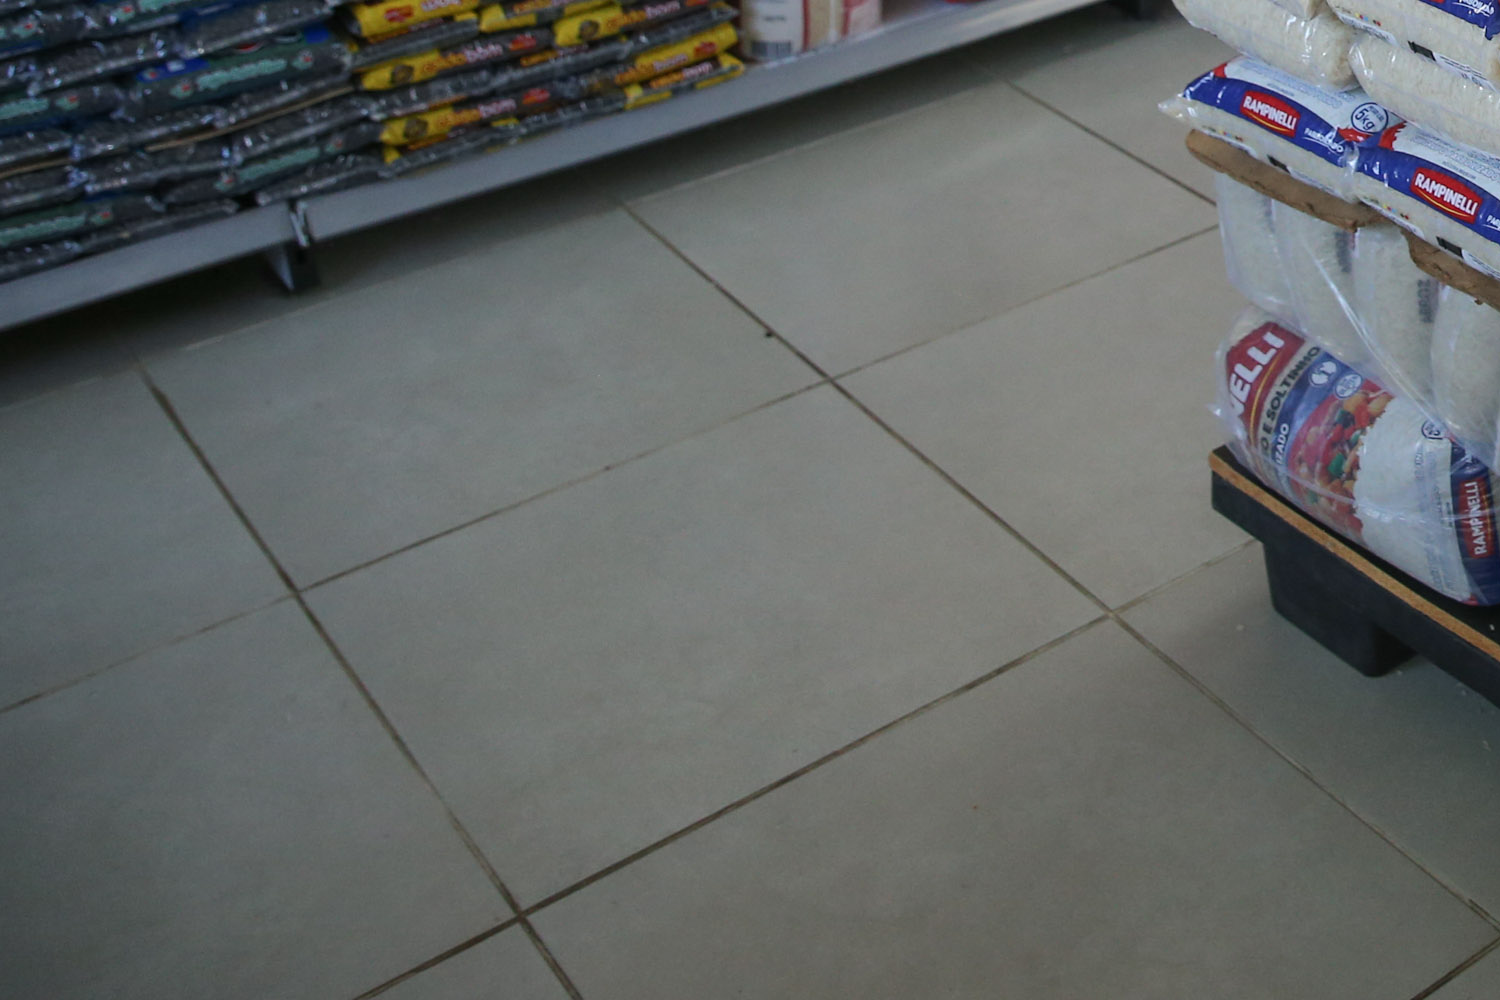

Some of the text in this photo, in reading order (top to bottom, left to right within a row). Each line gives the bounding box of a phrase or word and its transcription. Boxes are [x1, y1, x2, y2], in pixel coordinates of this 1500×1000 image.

[1243, 95, 1297, 130] RAMPINELLI
[1354, 105, 1375, 131] 5kg
[1414, 173, 1479, 216] RAMPINELLI
[1265, 345, 1320, 423] SOLTINHO
[1466, 481, 1487, 556] RAMPINELLI
